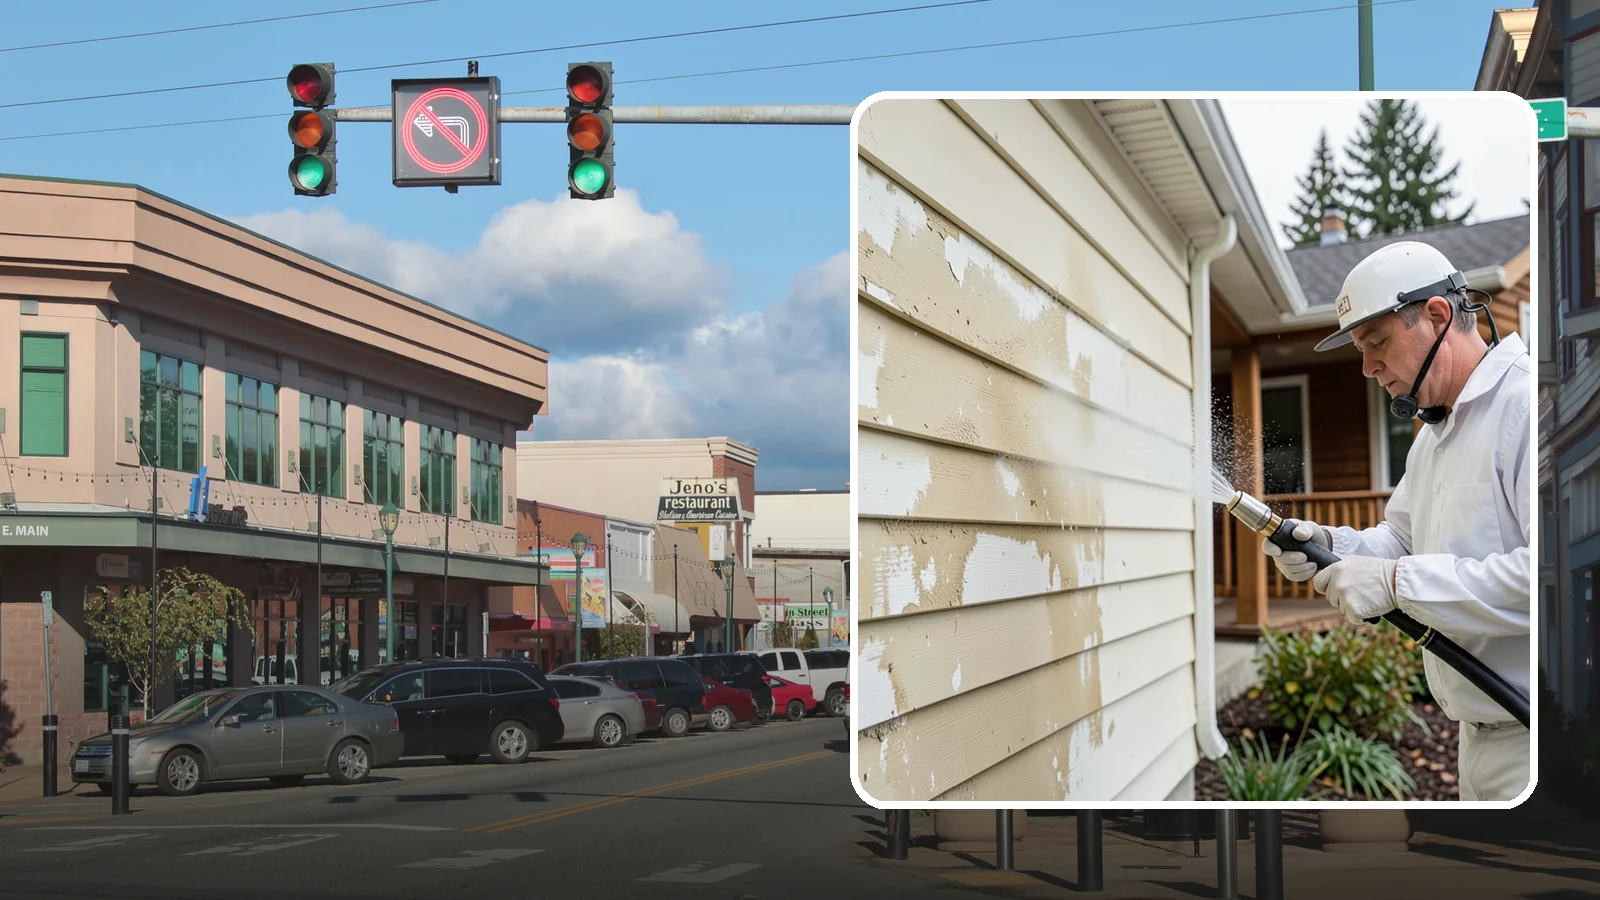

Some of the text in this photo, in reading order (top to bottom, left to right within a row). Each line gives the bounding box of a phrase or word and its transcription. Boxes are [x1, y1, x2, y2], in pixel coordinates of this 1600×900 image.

[669, 480, 728, 494] Jeno's
[665, 496, 731, 509] restaurant
[658, 510, 682, 519] Italian
[686, 510, 715, 519] American
[715, 509, 738, 519] Cuisine
[2, 525, 49, 536] E. MAIN
[797, 607, 829, 617] Street
[791, 619, 823, 627] lass
